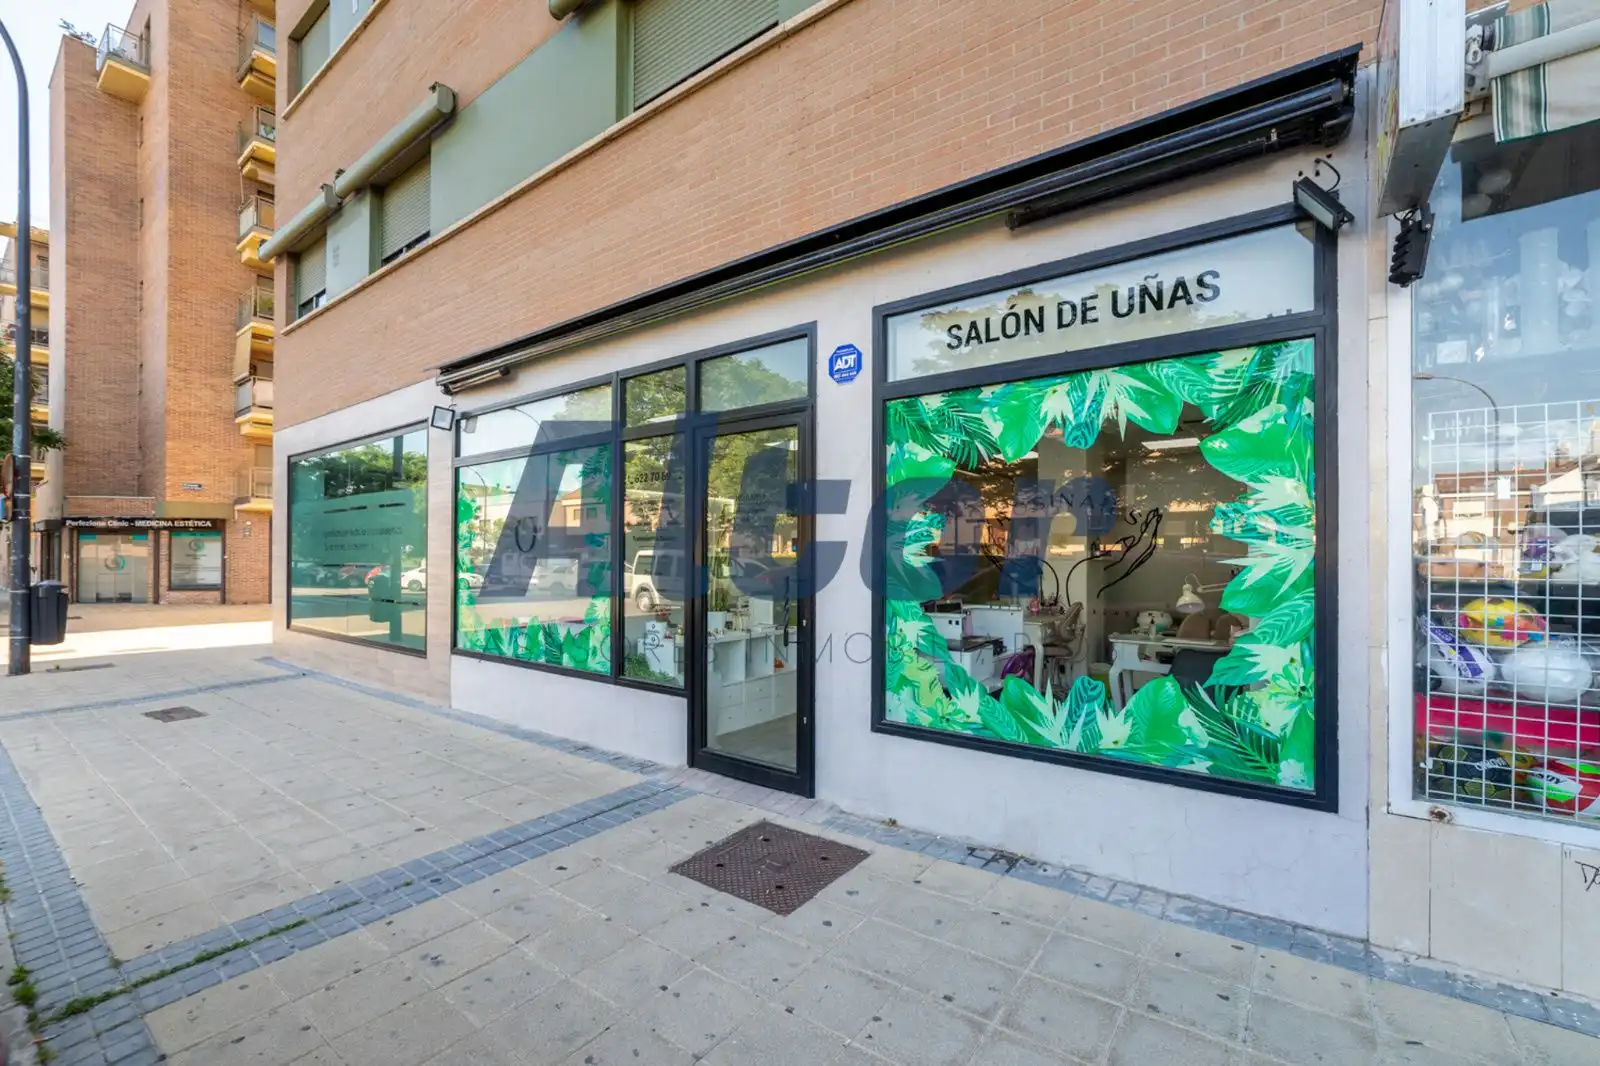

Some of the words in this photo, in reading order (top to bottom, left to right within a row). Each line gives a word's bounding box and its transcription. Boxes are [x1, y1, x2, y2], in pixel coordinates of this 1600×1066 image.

[946, 303, 1045, 350] SALÓN
[1056, 294, 1100, 330] DE
[1110, 269, 1222, 319] UÑAS
[834, 354, 857, 371] ADT
[134, 519, 173, 528] MEDICINA
[174, 519, 213, 528] ESTÉTICA
